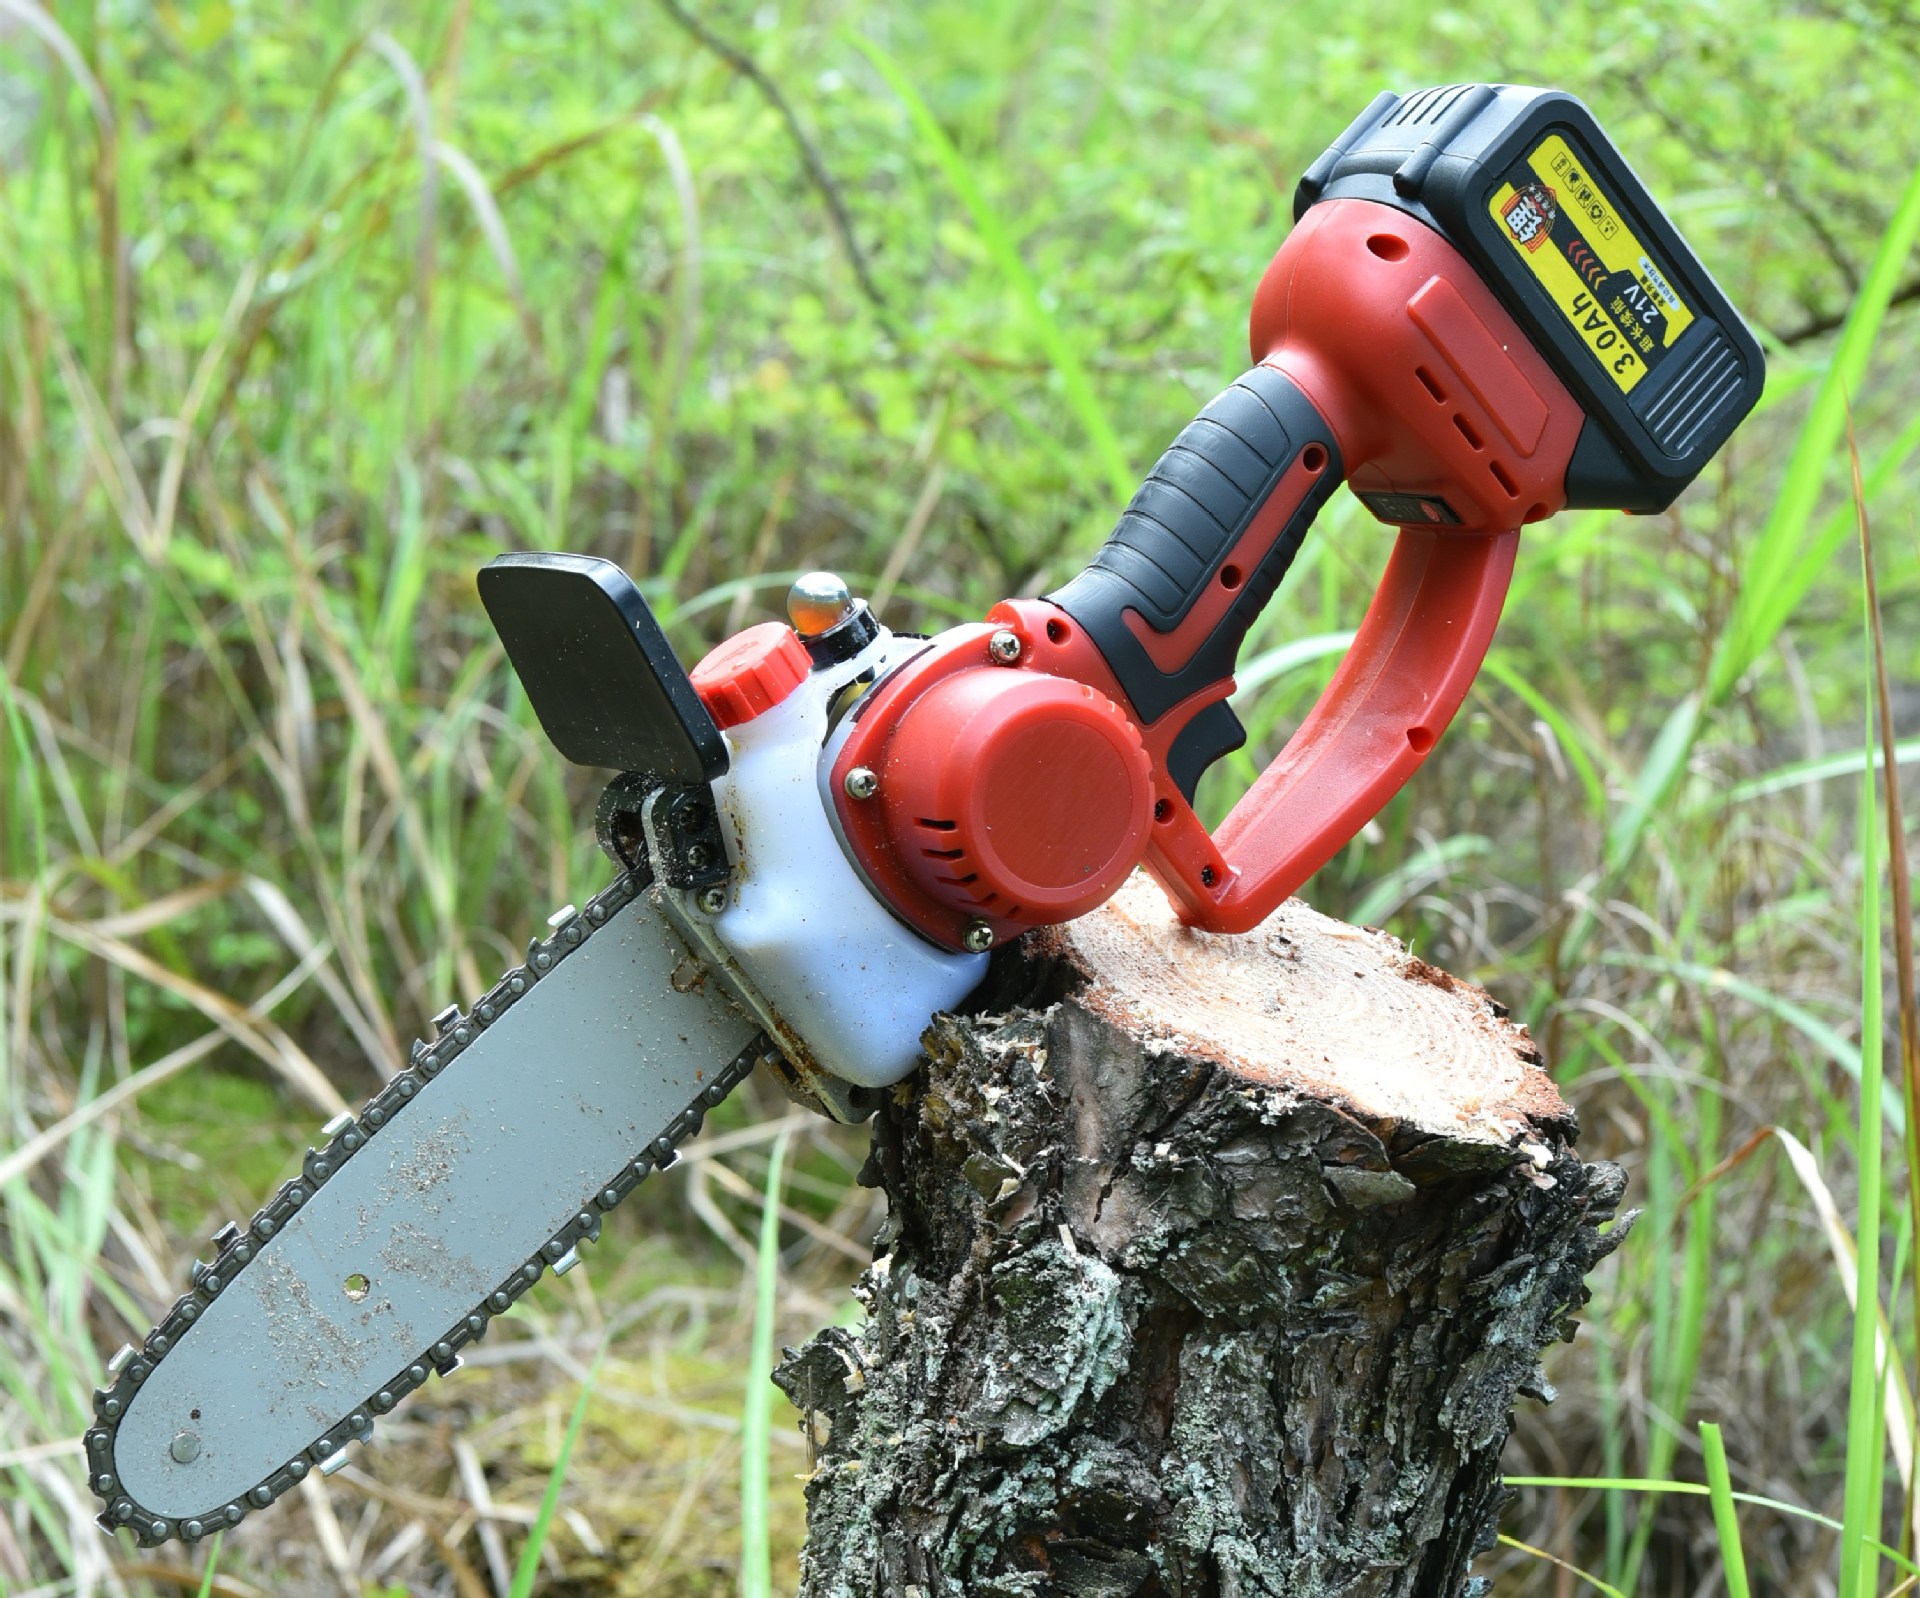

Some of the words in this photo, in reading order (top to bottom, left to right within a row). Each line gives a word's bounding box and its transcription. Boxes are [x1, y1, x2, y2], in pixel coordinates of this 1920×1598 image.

[1503, 195, 1547, 245] 锂
[1609, 295, 1655, 353] 超长续航
[1623, 282, 1660, 325] 21V
[1567, 291, 1636, 376] 3.0Ah
